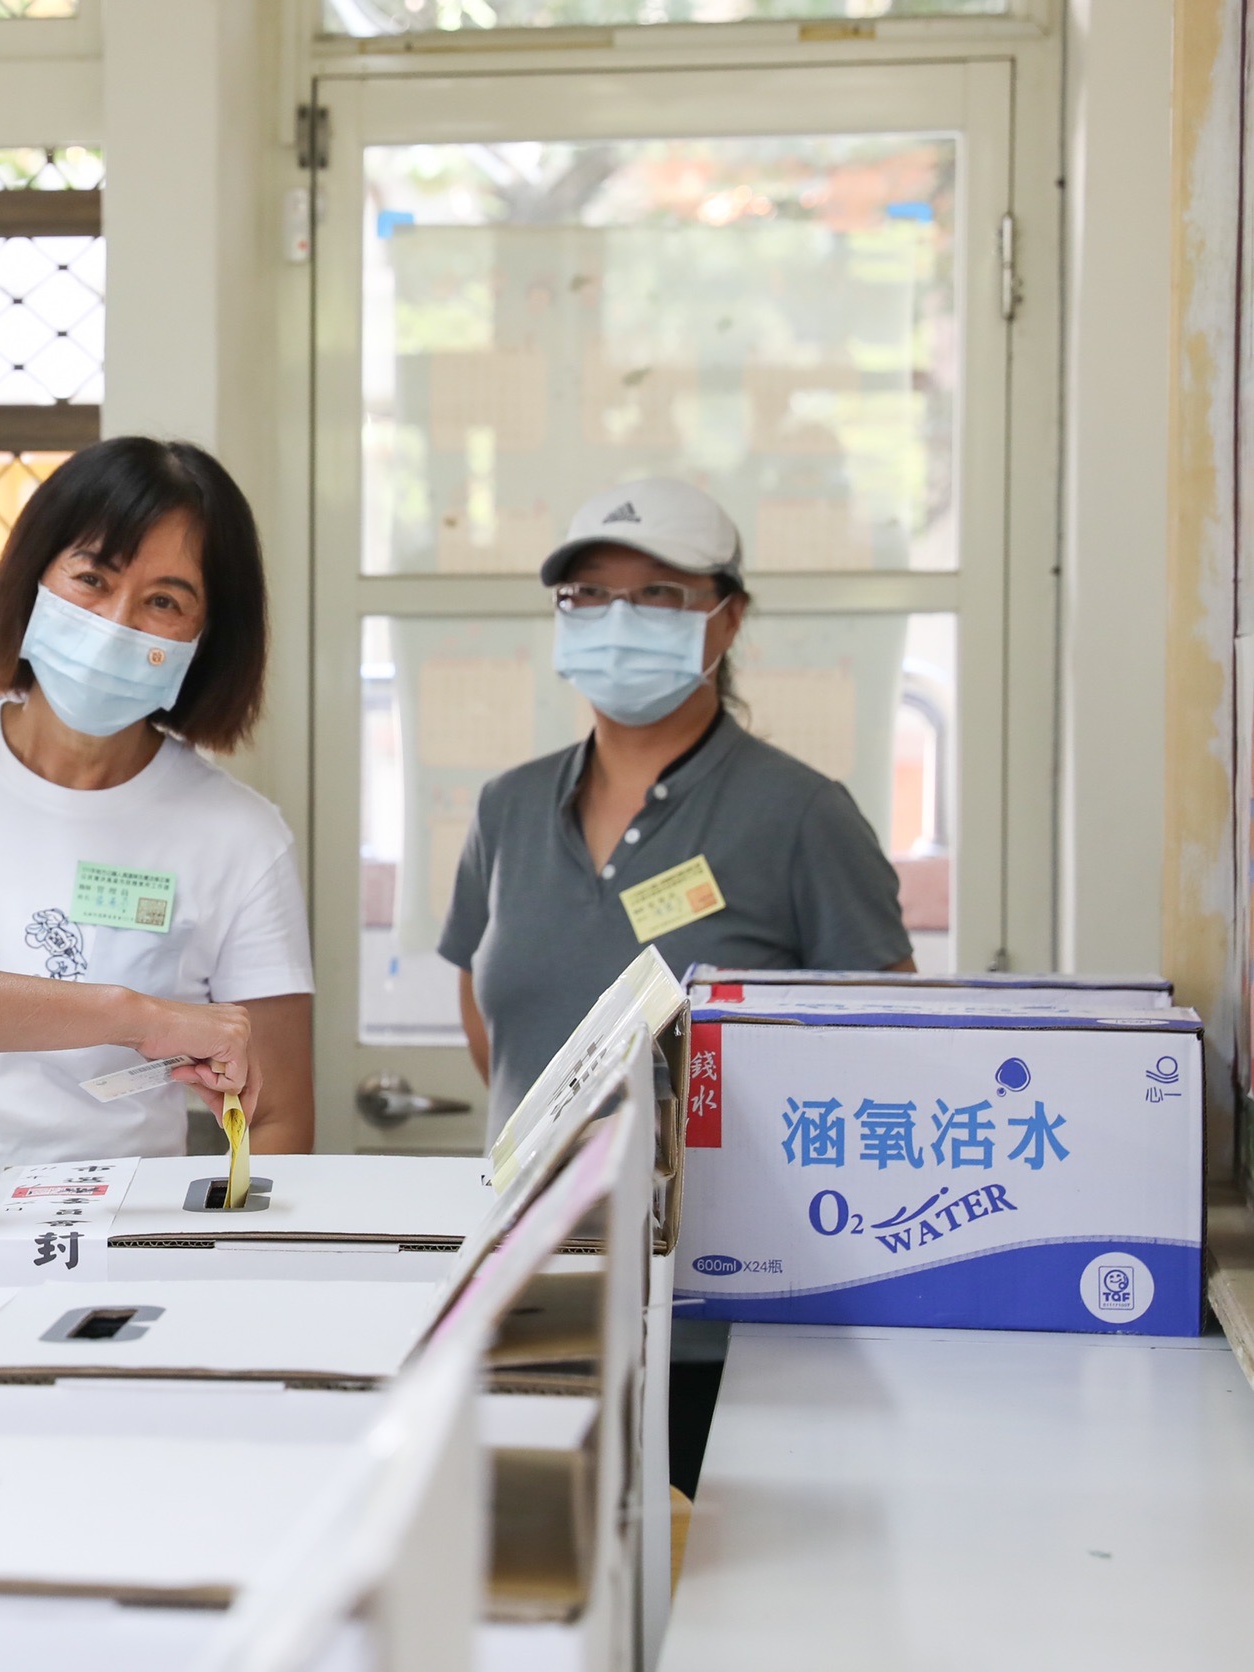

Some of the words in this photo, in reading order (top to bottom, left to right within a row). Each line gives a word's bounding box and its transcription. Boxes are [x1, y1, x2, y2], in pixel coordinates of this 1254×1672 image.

[781, 1097, 1070, 1170] 涵氧活水
[874, 1183, 1018, 1254] WATER
[33, 1231, 85, 1270] 封
[696, 1260, 738, 1272] 600ml
[1102, 1292, 1131, 1302] TQF
